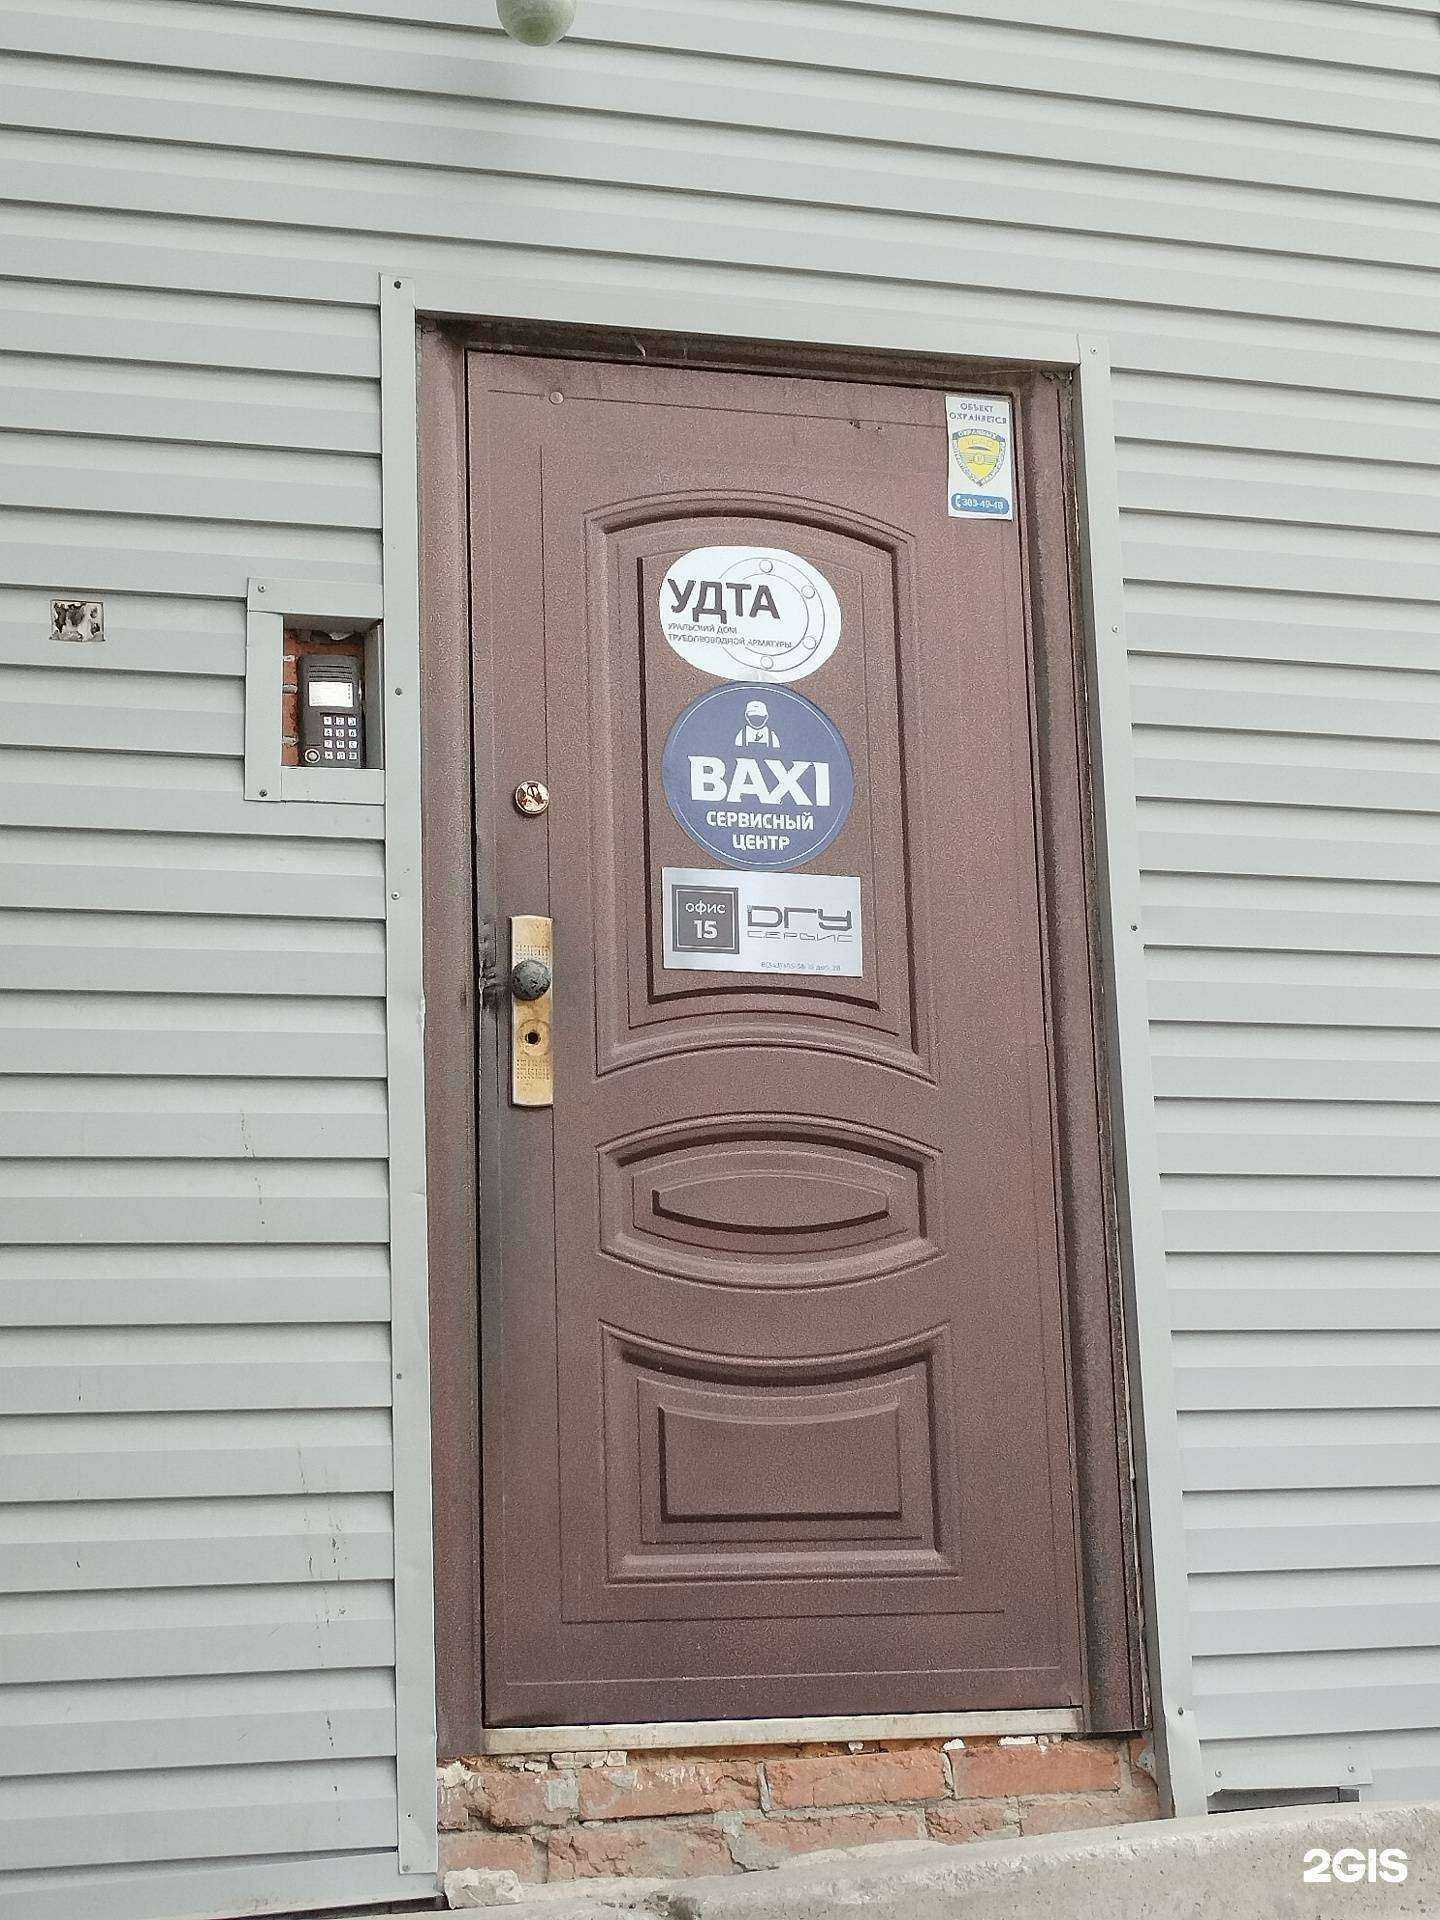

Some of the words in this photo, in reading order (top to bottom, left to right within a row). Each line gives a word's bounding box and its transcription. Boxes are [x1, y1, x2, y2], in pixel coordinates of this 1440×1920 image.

[960, 402, 994, 414] ОБЪЕКТ
[949, 412, 1007, 425] ОХРАНЯЕТСЯ
[667, 578, 780, 624] УДТА
[667, 622, 715, 633] УРАЛЬСКИЙ
[716, 625, 738, 635] ДОМ
[668, 633, 746, 646] ТРУБОПРОВОДНОЙ
[746, 639, 792, 649] АРМАТУРЫ
[687, 755, 831, 807] BAXI
[706, 811, 814, 831] СЕРВИСНЫЙ
[732, 833, 791, 851] ЦЕНТР
[693, 920, 718, 940] 15
